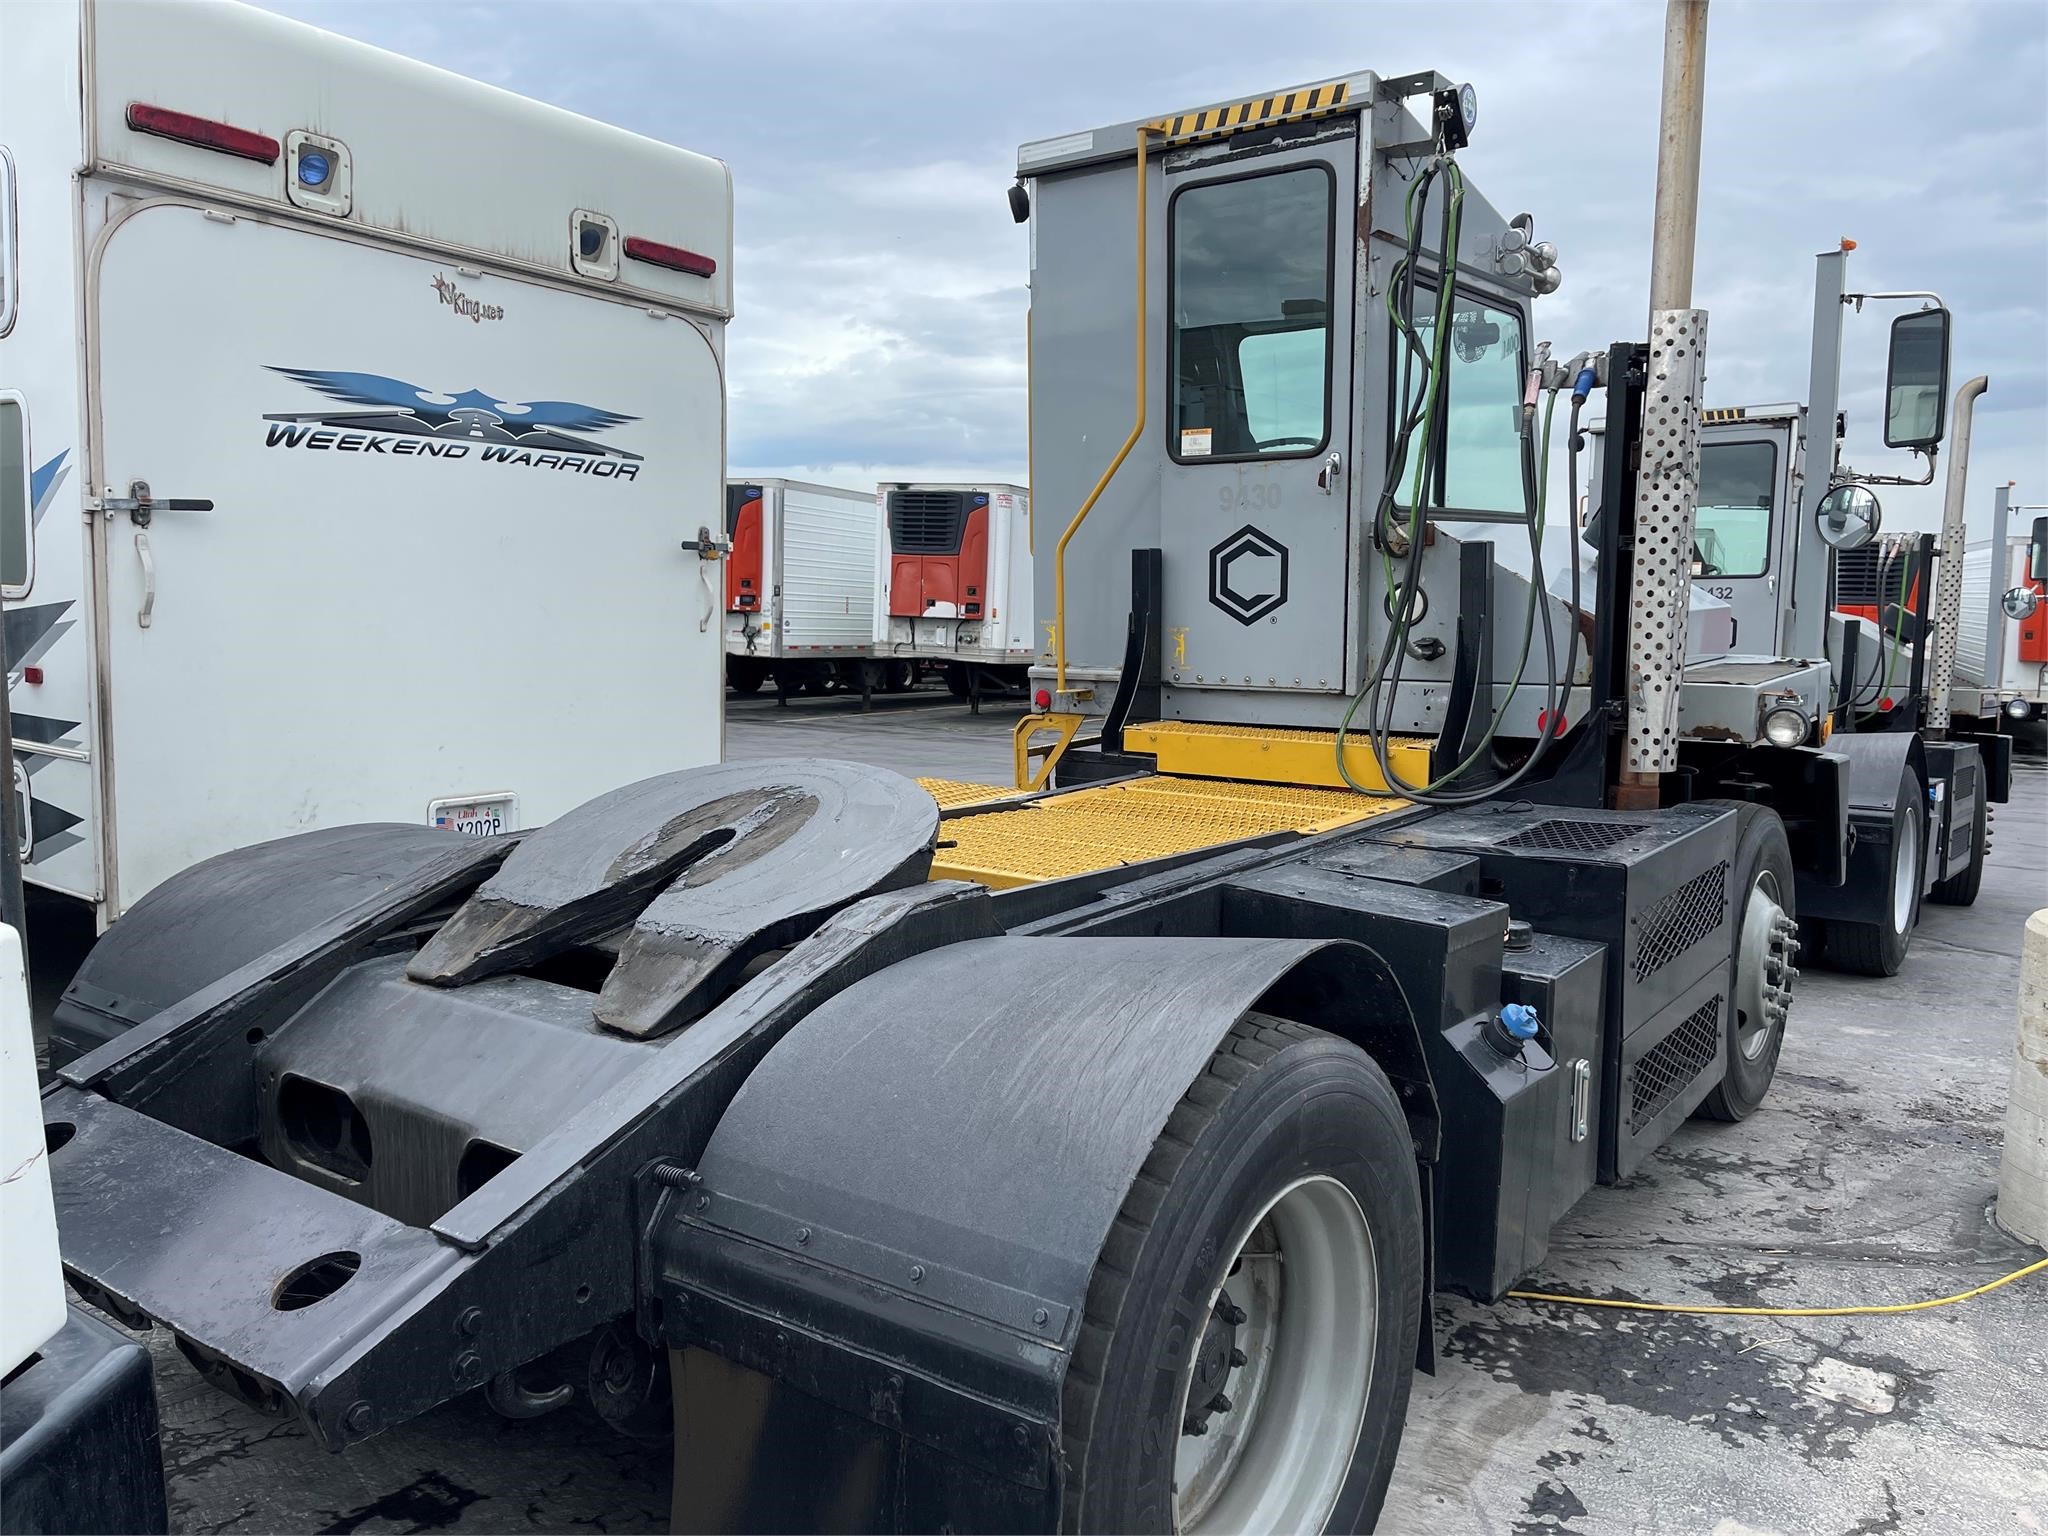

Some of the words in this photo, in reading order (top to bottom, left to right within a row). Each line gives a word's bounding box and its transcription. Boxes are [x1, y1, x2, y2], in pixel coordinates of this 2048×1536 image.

[265, 423, 471, 459] WEEKEND
[481, 446, 640, 482] WARRIOR
[1218, 483, 1282, 513] 9430
[458, 808, 478, 818] Utah
